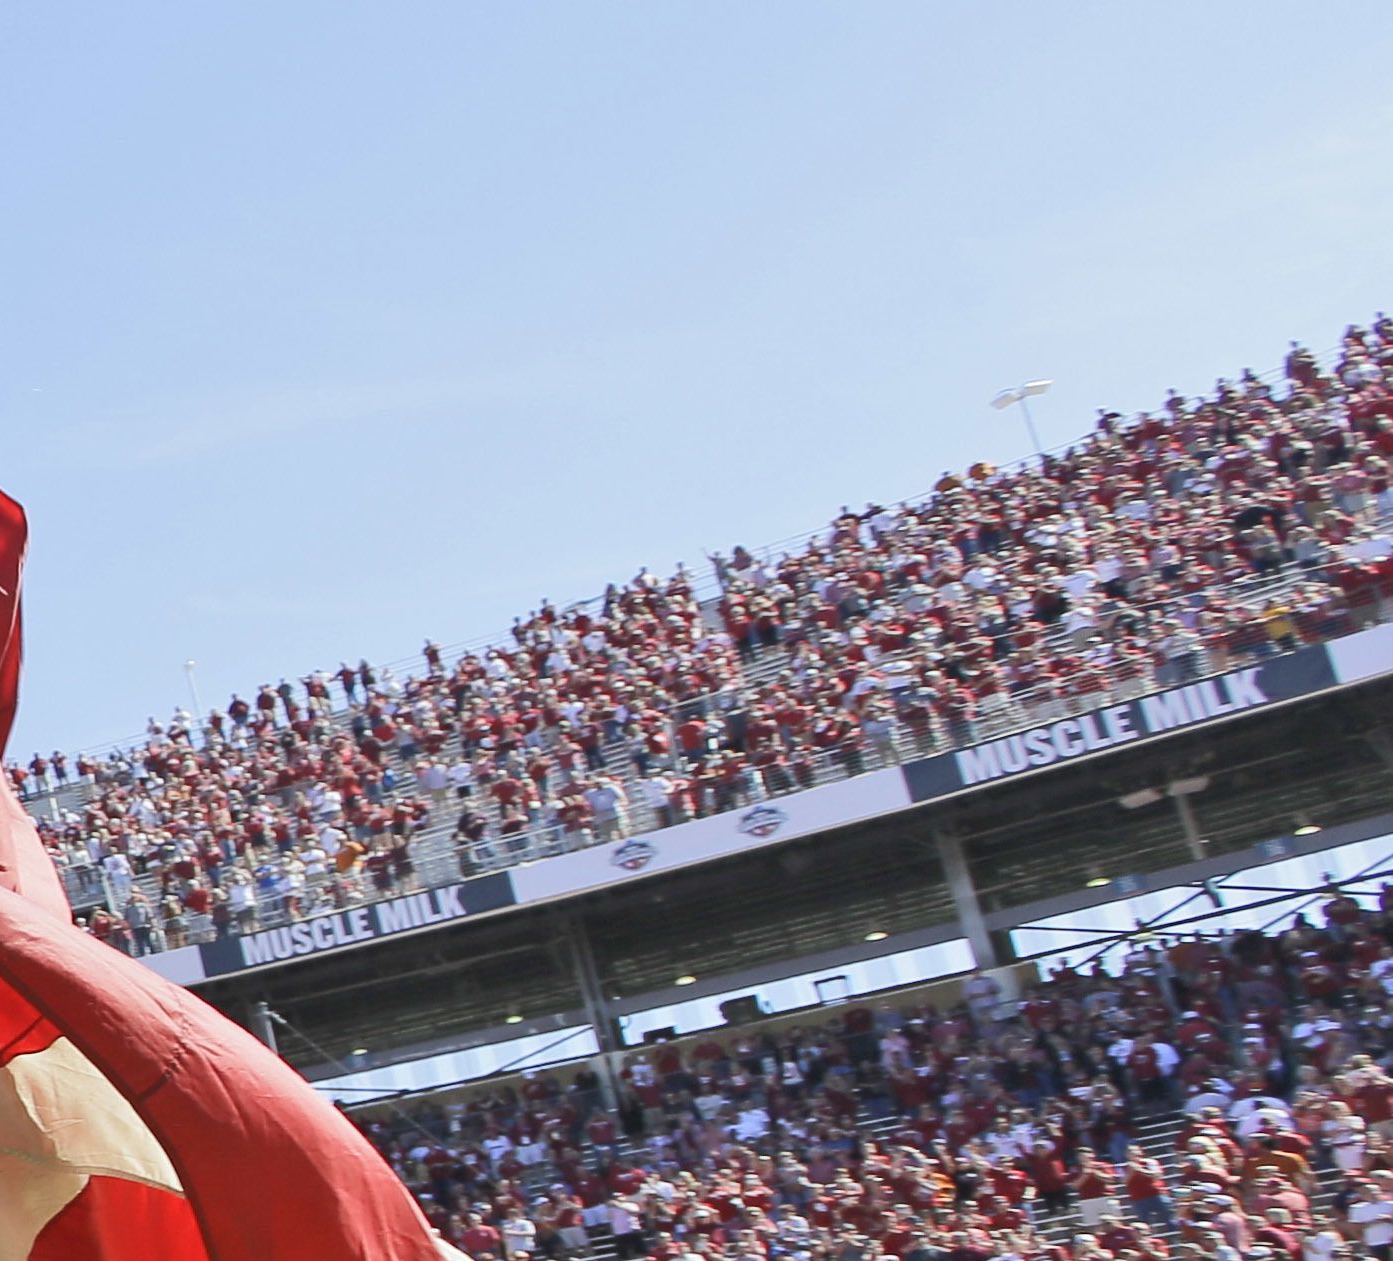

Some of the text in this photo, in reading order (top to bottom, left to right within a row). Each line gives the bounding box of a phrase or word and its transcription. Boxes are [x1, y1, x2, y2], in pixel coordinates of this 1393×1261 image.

[955, 668, 1270, 788] MUSCLE MILK
[240, 885, 468, 967] MUSCLE MILK
